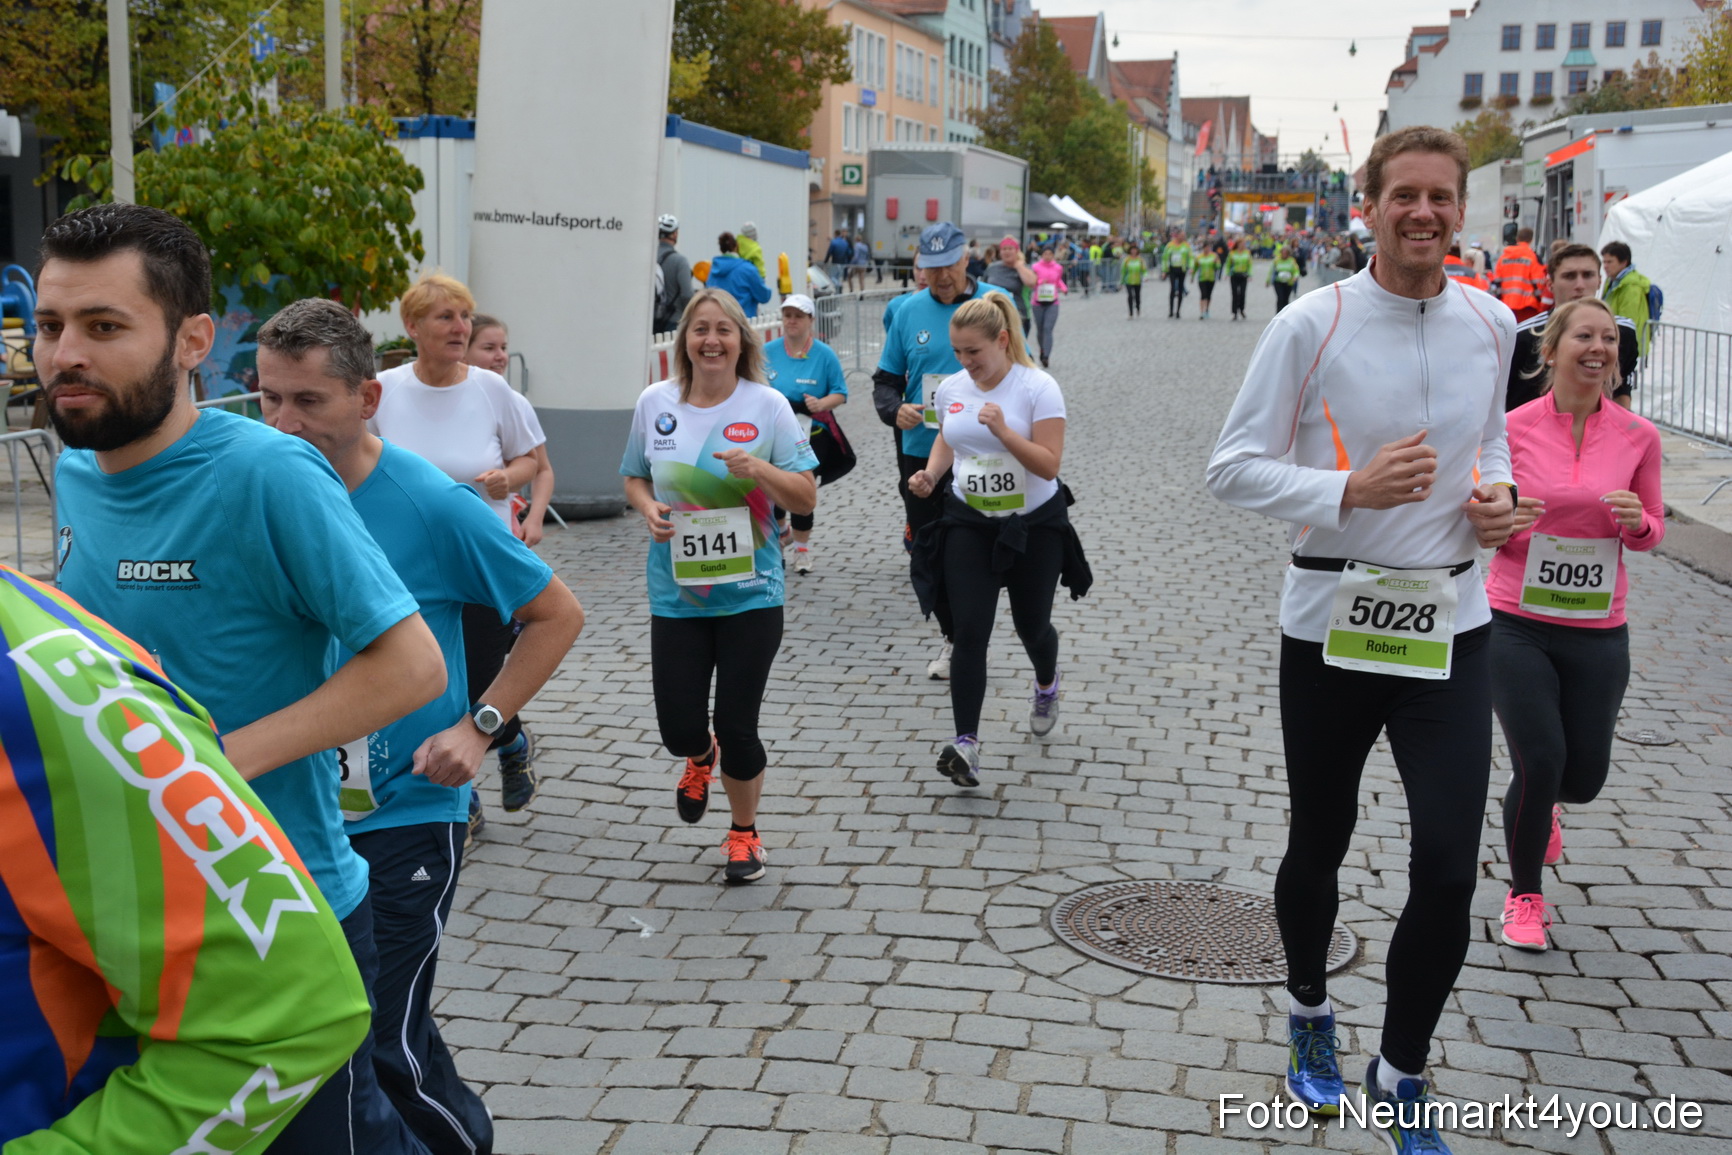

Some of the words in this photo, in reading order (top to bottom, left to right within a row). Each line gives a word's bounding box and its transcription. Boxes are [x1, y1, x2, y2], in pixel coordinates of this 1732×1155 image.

[845, 166, 861, 184] D
[727, 427, 756, 438] Hervis
[654, 438, 677, 447] PARTL
[967, 472, 1016, 493] 5138
[682, 531, 737, 557] 5141
[116, 559, 199, 582] BOCK
[700, 563, 727, 573] Gunda
[1538, 560, 1604, 588] 5093
[137, 583, 144, 592] by
[145, 583, 165, 591] smart
[167, 583, 201, 591] concepts
[1388, 578, 1430, 590] BOCK
[1549, 592, 1586, 605] Theresa
[1348, 595, 1438, 634] 5028
[1365, 639, 1408, 656] Robert
[6, 628, 319, 961] BOCK
